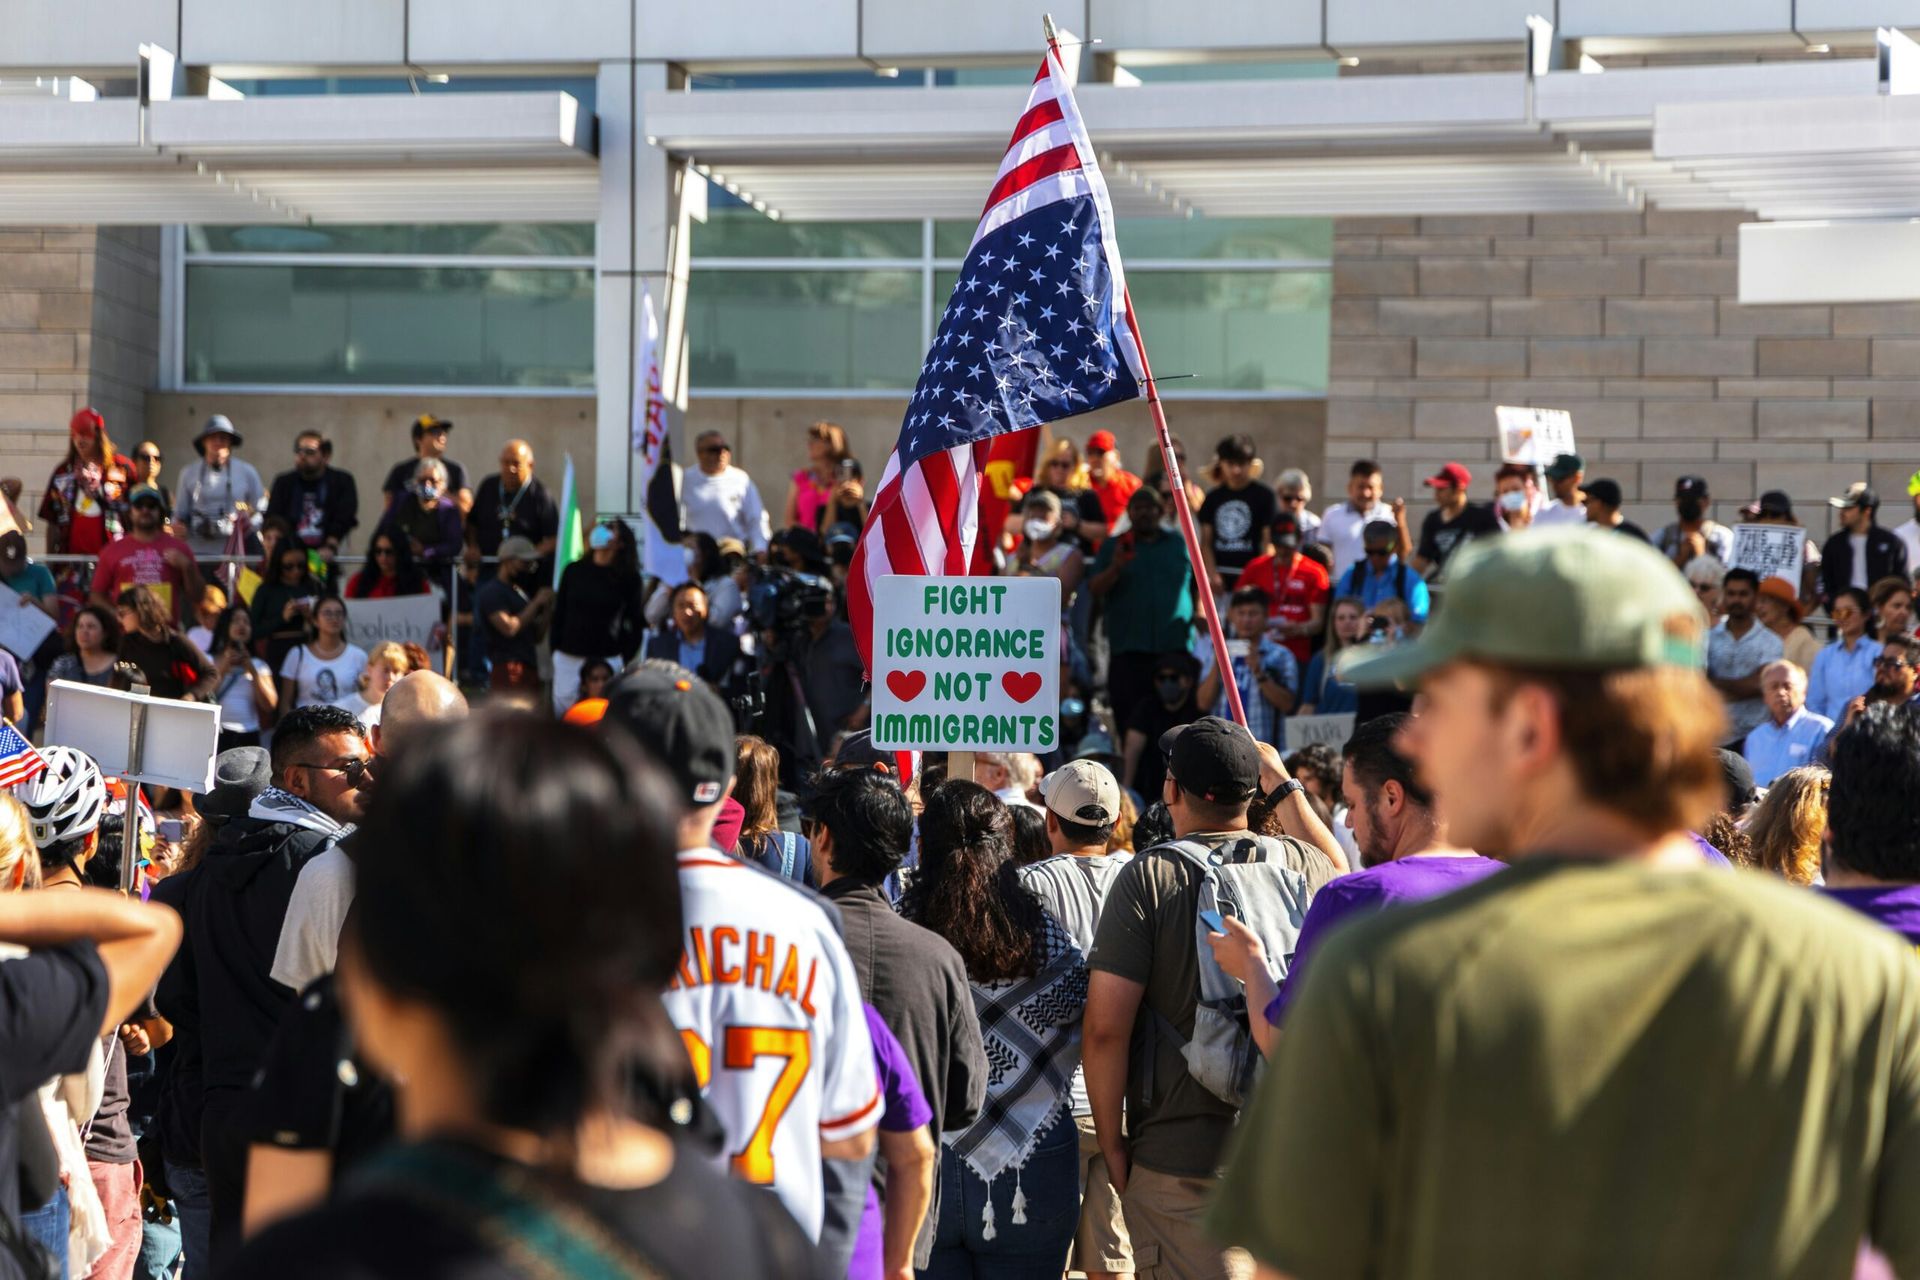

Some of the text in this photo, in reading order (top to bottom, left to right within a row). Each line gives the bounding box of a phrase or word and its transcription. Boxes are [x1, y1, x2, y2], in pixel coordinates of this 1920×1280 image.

[924, 585, 1007, 615] FIGHT
[886, 627, 1045, 659] IGNORANCE
[934, 671, 993, 702] NOT
[875, 713, 1055, 747] IMMIGRANTS
